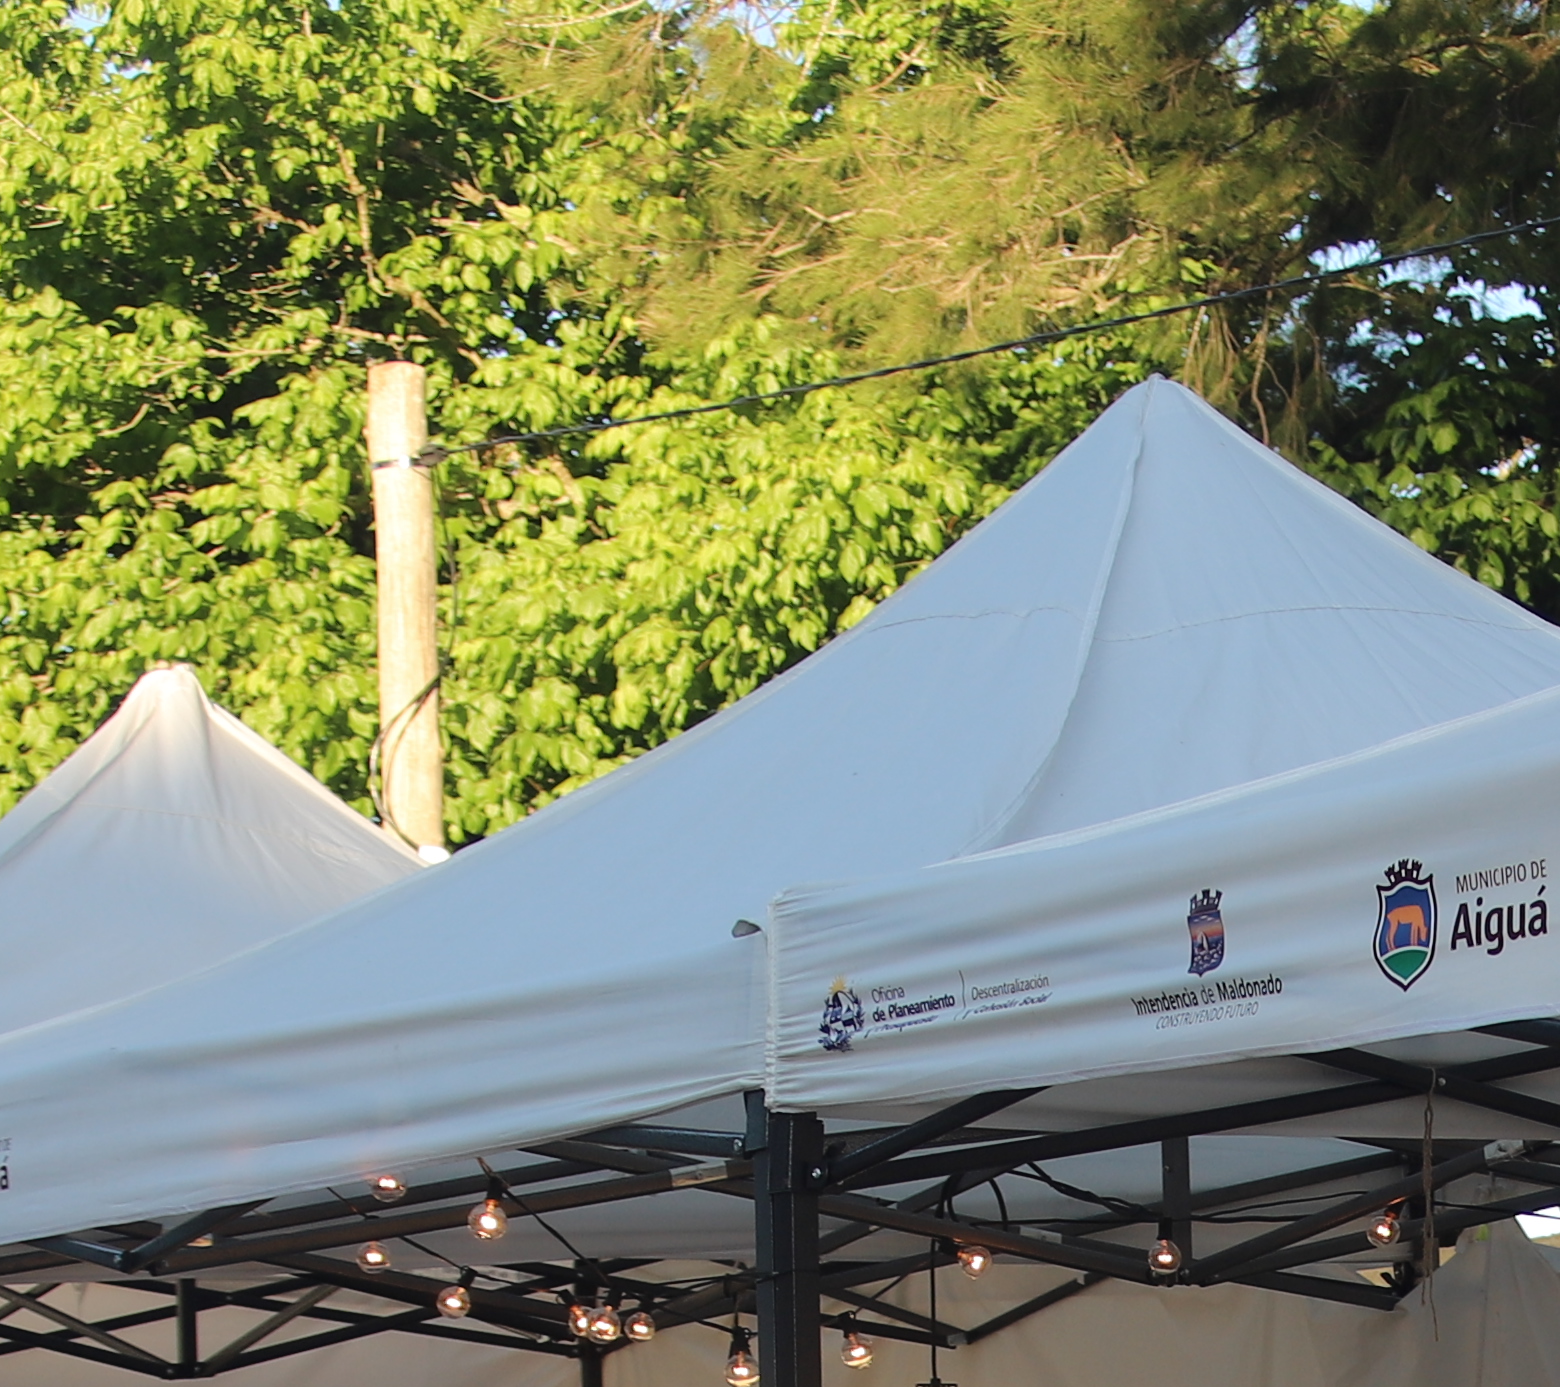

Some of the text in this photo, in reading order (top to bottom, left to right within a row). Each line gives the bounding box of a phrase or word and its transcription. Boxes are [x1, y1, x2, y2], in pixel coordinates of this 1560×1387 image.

[1456, 859, 1548, 894] MUNICIPIO DE
[1450, 884, 1548, 956] Aiguá
[871, 985, 906, 1004] Oficina
[970, 973, 1050, 1001] Descentralización
[1130, 973, 1283, 1016] Intendencia de Maldonado
[872, 992, 956, 1023] de Planeamiento
[1155, 1001, 1259, 1030] CONSTRUYENDO FUTURO
